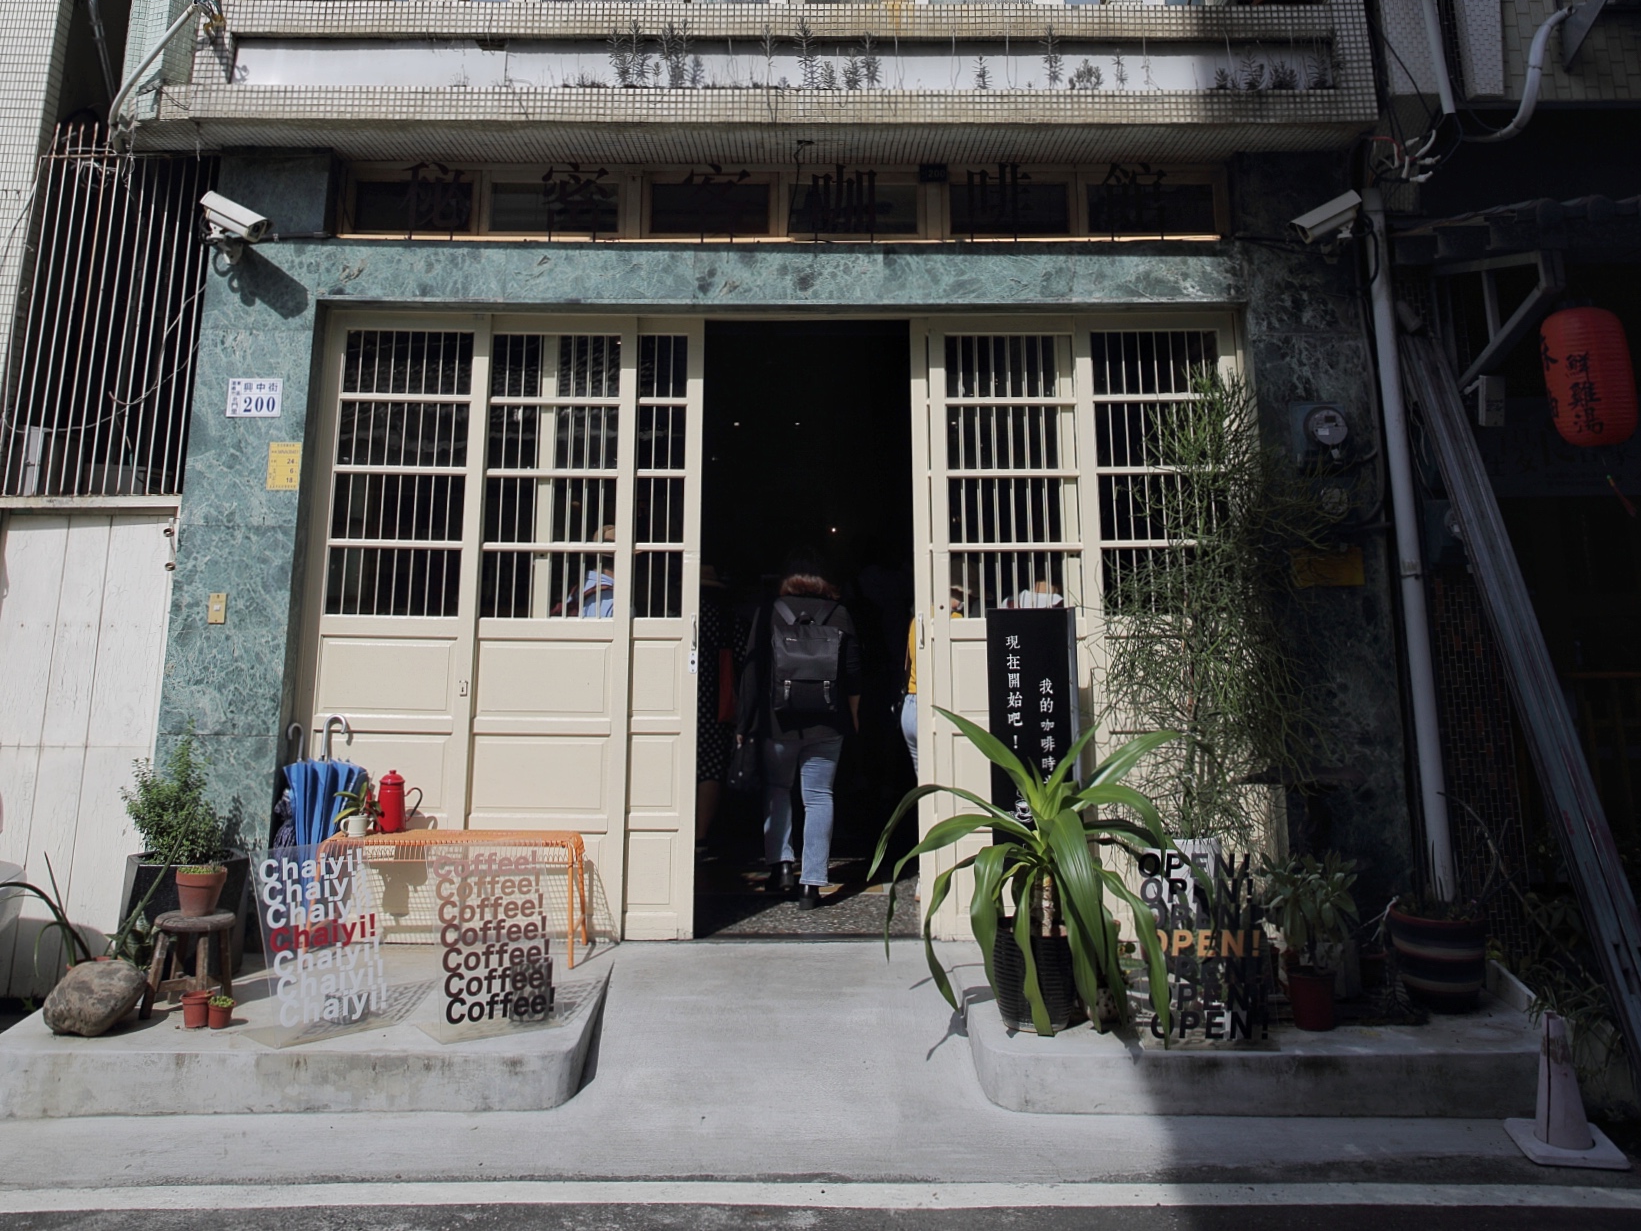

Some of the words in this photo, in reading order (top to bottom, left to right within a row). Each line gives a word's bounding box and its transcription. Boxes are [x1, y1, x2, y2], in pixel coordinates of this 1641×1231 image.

[928, 168, 946, 178] 200
[243, 382, 278, 393] 興中街
[243, 396, 276, 413] 200
[260, 848, 362, 883] Chaiyi!
[433, 850, 537, 879] Coffee!
[1138, 853, 1251, 878] OPEN!
[436, 871, 541, 901] Coffee!
[438, 893, 544, 925] Coffee!
[270, 913, 376, 953] Chaiyi!
[440, 915, 547, 948] Coffee!
[273, 936, 380, 977] Chaiyi!
[442, 938, 550, 973] Coffee!
[277, 958, 384, 1003] Chaiyi!
[444, 960, 553, 999] Coffee!
[280, 982, 387, 1028] Chaiyi!
[446, 987, 555, 1025] Coffee!
